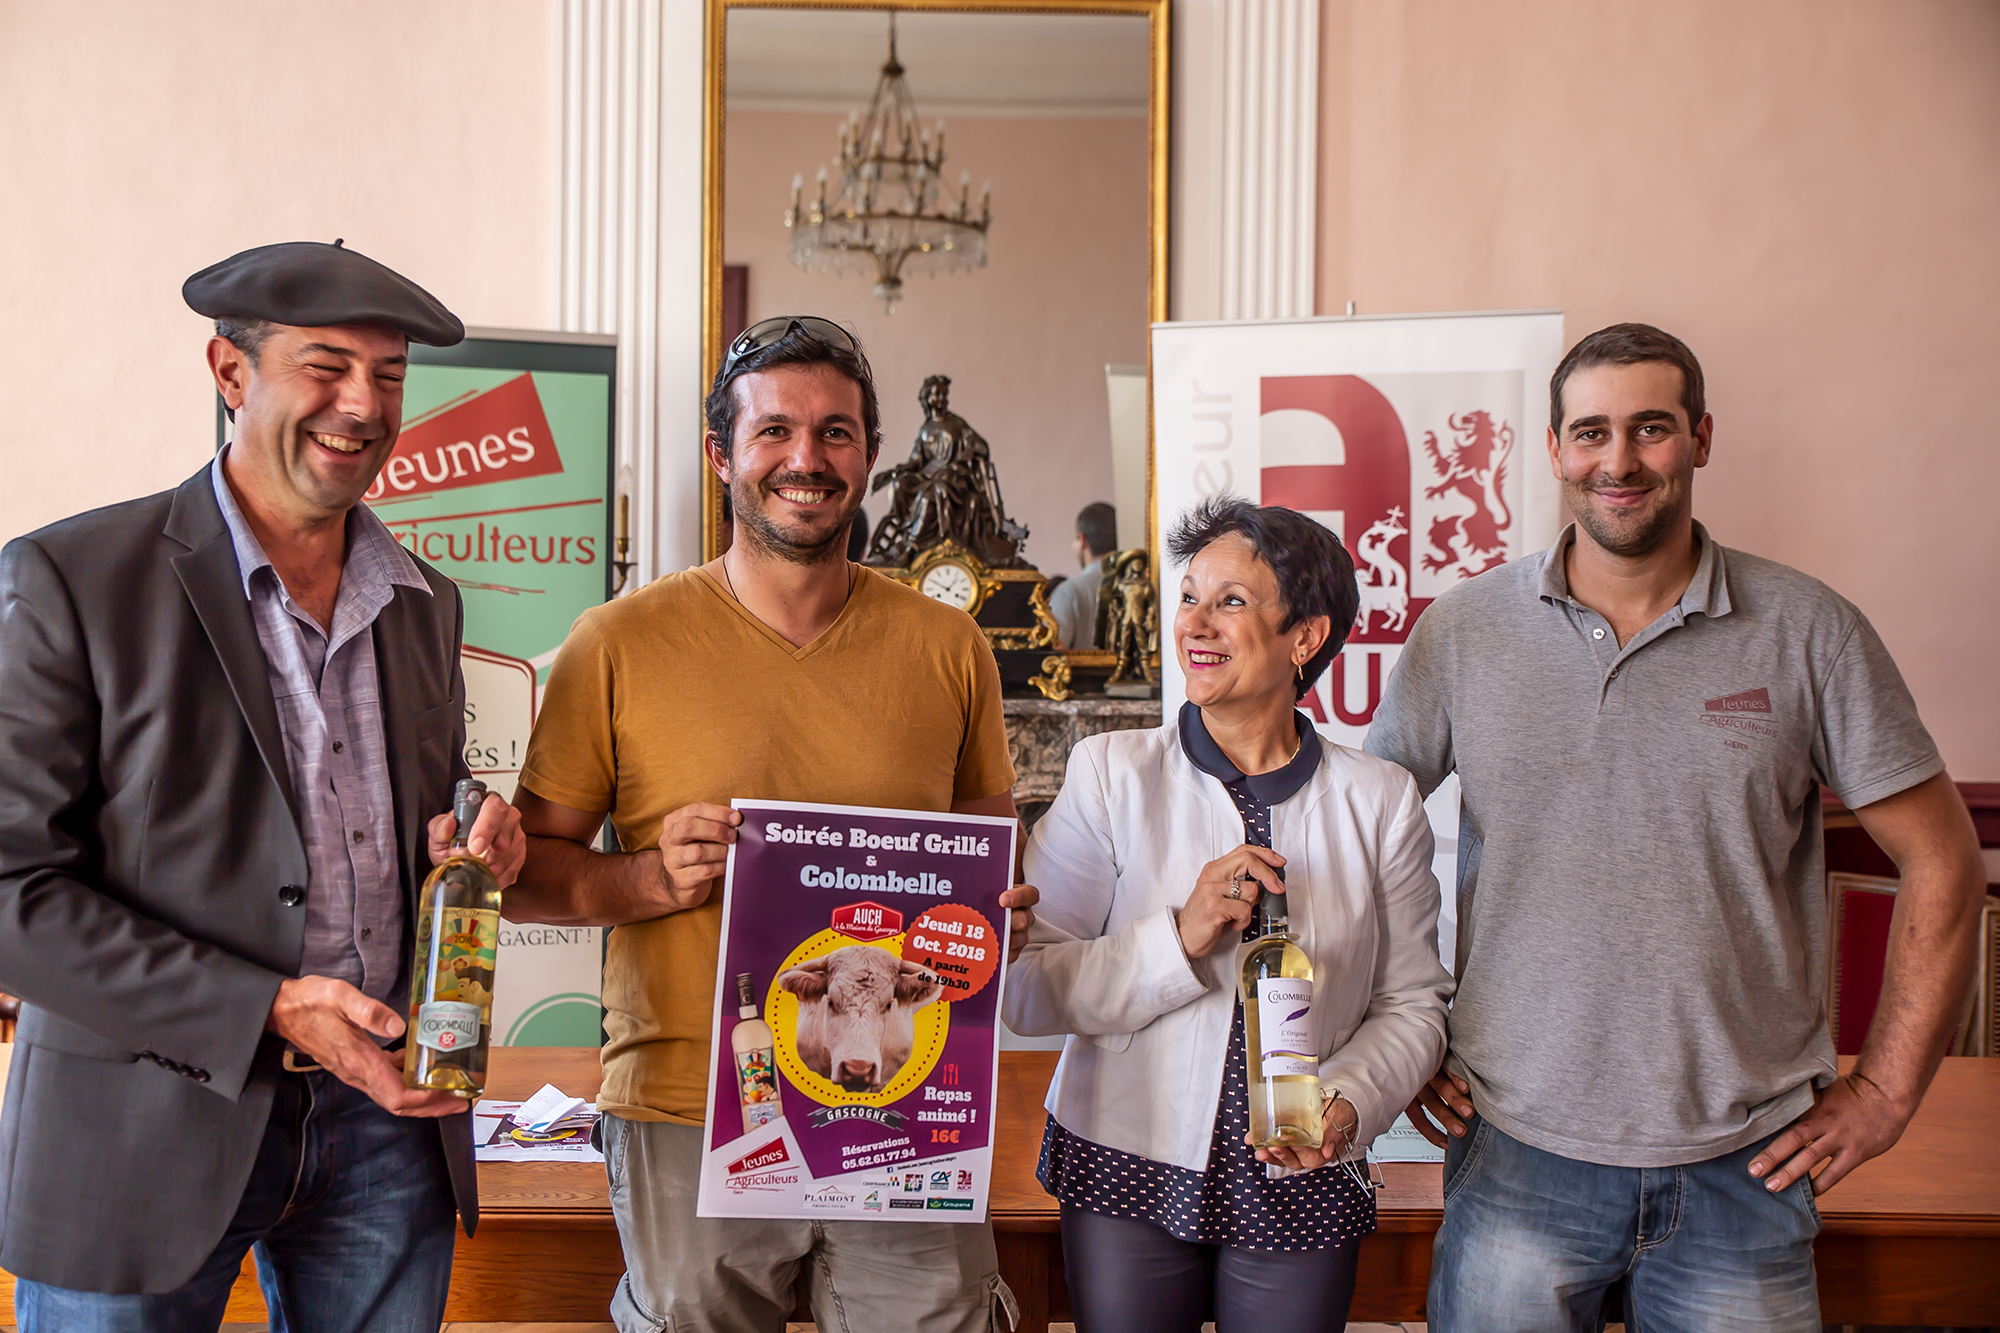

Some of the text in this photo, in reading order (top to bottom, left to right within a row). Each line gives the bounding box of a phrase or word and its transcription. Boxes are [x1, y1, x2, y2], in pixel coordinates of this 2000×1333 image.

[1722, 698, 1767, 711] Jeunes
[1708, 714, 1779, 739] Agriculteurs
[1723, 740, 1750, 750] GERS
[765, 822, 990, 857] Soirée Boeuf Grillé
[865, 855, 878, 867] &
[800, 864, 953, 896] Colombelle
[852, 907, 883, 926] AUCH
[918, 915, 985, 940] Jeudi 18
[913, 935, 986, 961] Oct. 2018
[923, 957, 970, 974] A partir
[917, 972, 971, 991] de 19h30
[924, 1086, 972, 1104] Repas
[826, 1107, 888, 1122] GASCOGNE
[917, 1108, 977, 1123] animé !
[930, 1129, 961, 1144] 16€
[841, 1136, 910, 1156] Réservations
[741, 1149, 784, 1171] Jeunes
[842, 1147, 917, 1170] 05.62.61.77.94
[733, 1174, 799, 1189] Agriculteurs
[804, 1193, 856, 1203] PLAIMONT
